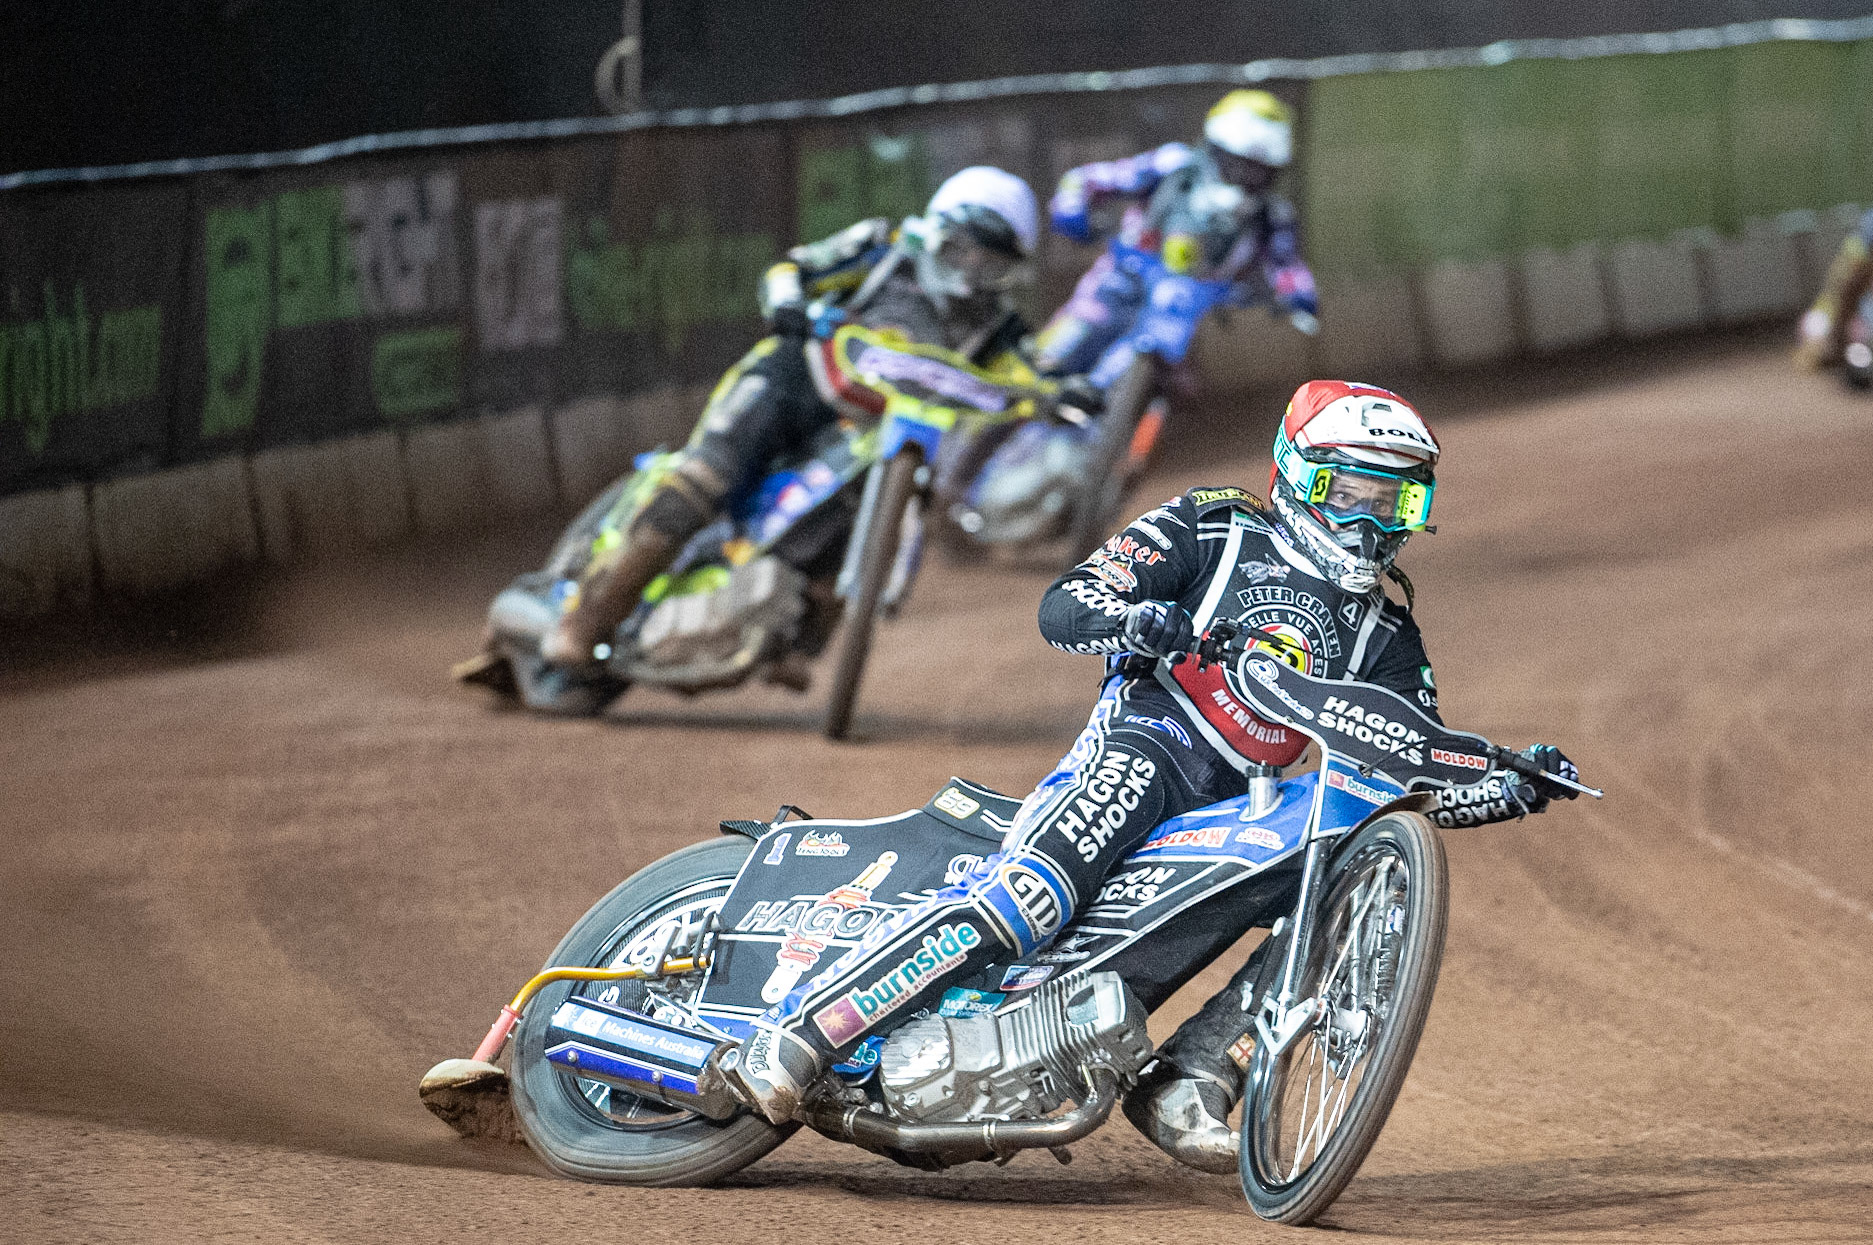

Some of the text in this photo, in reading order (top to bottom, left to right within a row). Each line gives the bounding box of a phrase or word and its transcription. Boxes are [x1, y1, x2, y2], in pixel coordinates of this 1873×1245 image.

[1237, 586, 1341, 658] PETER CRAVEN
[1246, 611, 1280, 630] ELLE
[1287, 612, 1314, 635] VUE
[1342, 601, 1359, 625] 4
[1211, 688, 1287, 744] MEMORIAL
[1317, 712, 1424, 766] SHOCKS
[1322, 696, 1427, 749] HAGON
[1433, 751, 1487, 768] MOLDOW
[1055, 751, 1131, 844] HAGON
[1077, 757, 1156, 863] SHOCKS
[1347, 777, 1396, 803] burnsid
[852, 925, 978, 1018] burnside
[869, 991, 912, 1022] chartered
[914, 954, 966, 991] accountants
[601, 1021, 656, 1046] Machines
[654, 1036, 705, 1060] Australia
